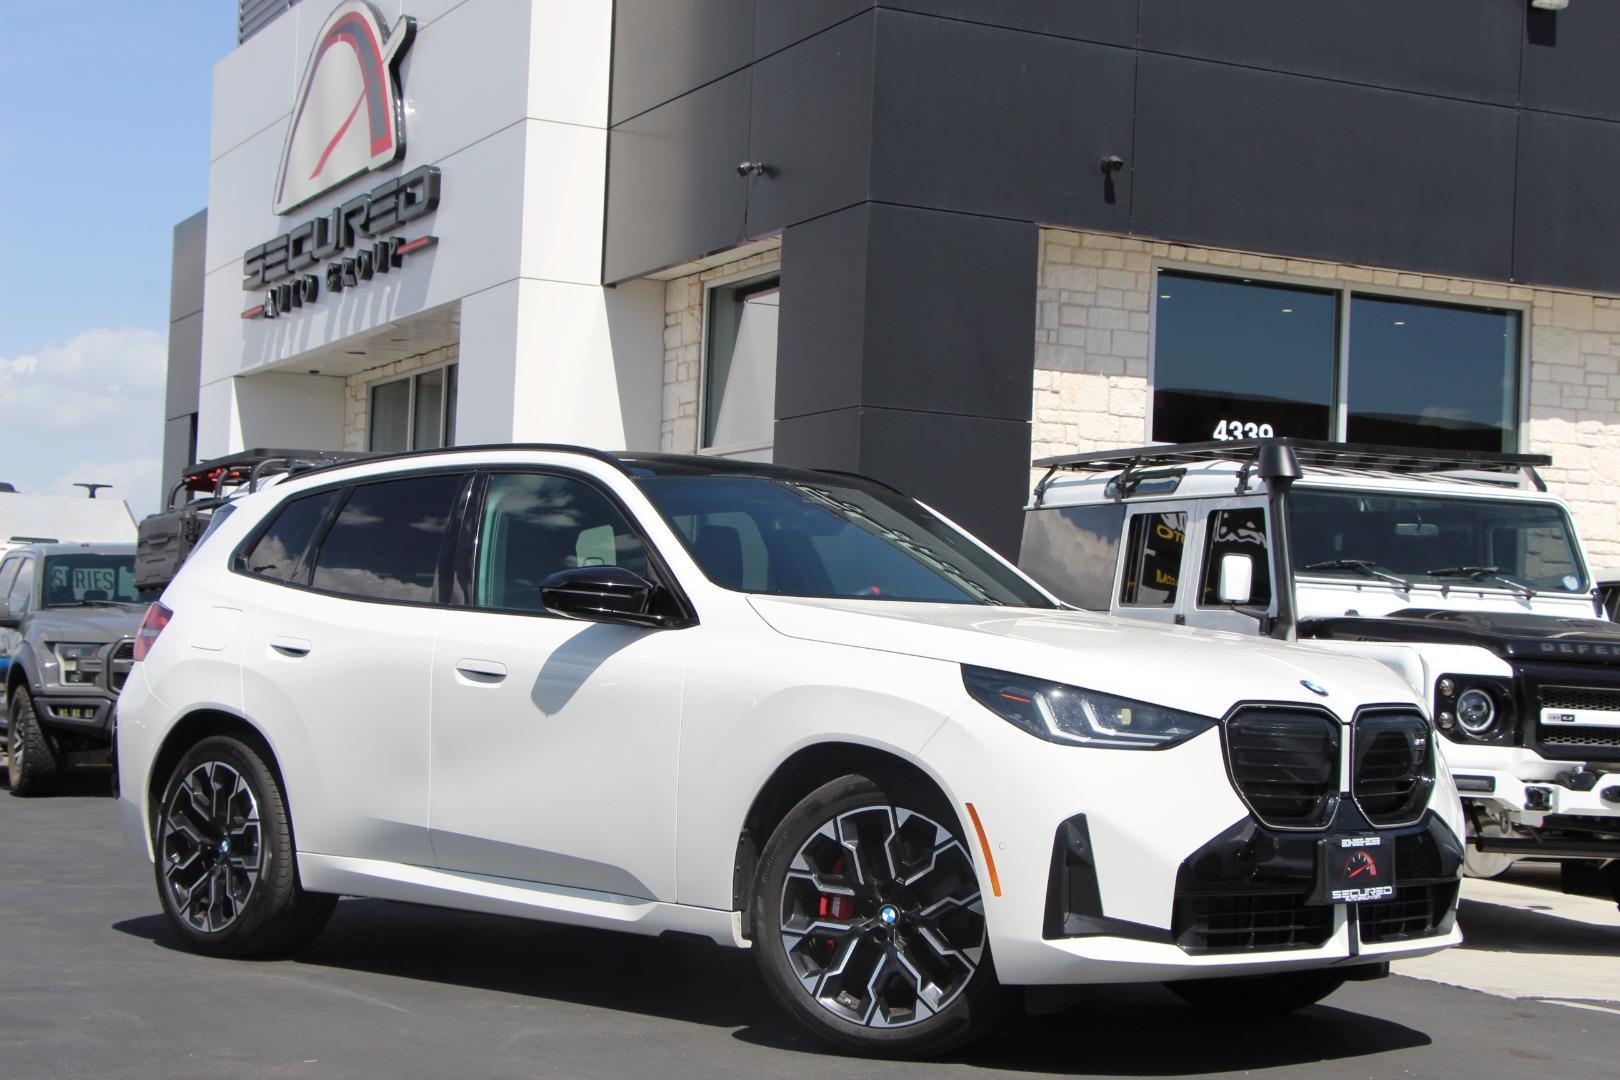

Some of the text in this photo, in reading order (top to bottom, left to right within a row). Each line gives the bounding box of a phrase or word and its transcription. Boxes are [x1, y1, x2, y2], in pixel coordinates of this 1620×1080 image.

[242, 164, 441, 291] SECURED
[263, 236, 406, 319] AUTO GROUP
[1332, 886, 1393, 900] SECURED
